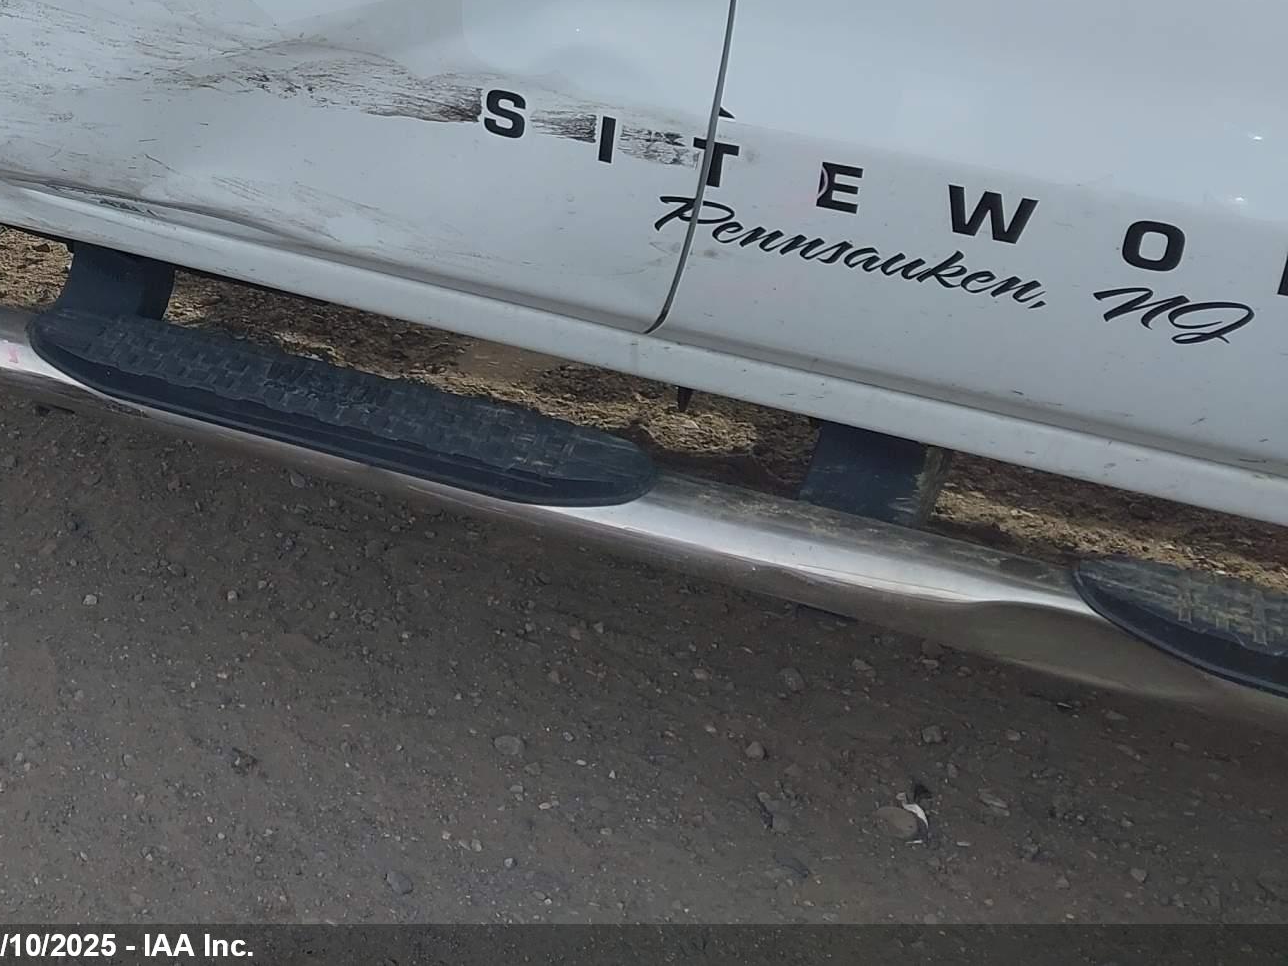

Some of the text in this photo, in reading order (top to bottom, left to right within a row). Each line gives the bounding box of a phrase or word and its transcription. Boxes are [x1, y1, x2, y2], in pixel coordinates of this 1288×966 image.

[484, 89, 1288, 296] SITEWO
[654, 195, 1255, 345] Pennsauken, NJ
